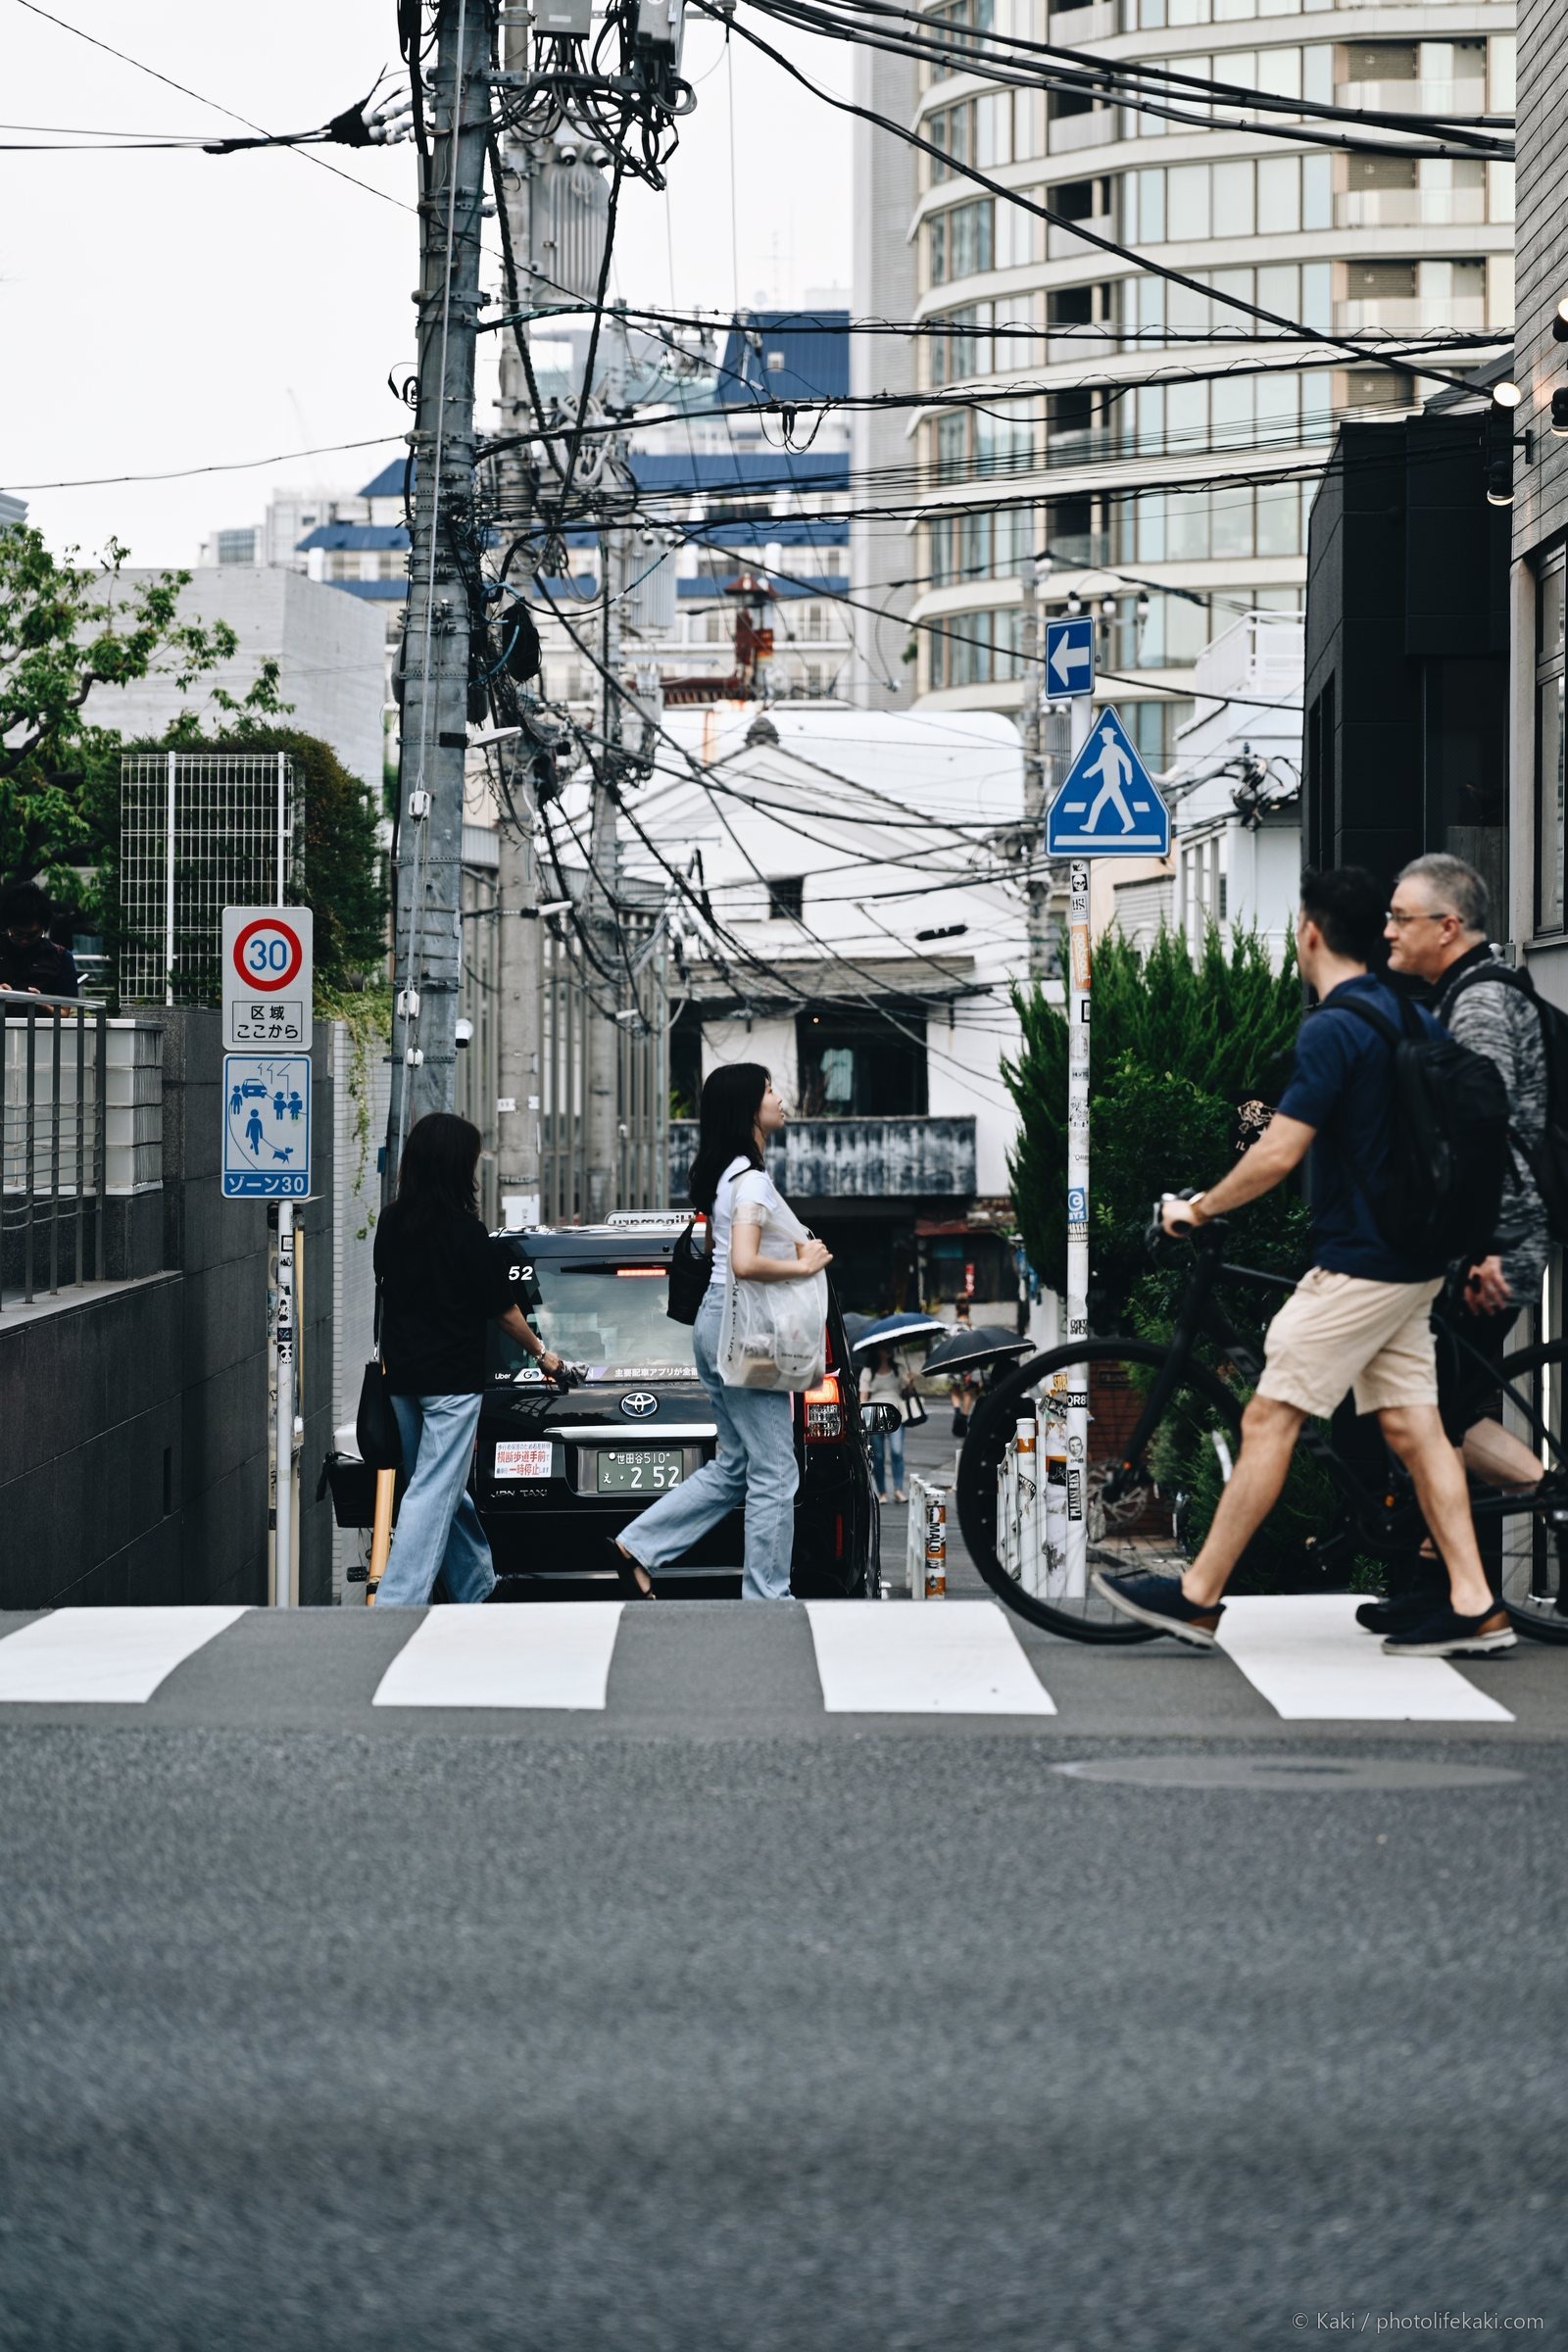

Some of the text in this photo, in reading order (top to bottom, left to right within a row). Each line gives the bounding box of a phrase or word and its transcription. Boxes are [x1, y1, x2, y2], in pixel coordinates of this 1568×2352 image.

[249, 939, 287, 971] 30
[251, 1005, 285, 1020] 区域
[237, 1024, 298, 1039] ここから
[228, 1176, 305, 1194] ゾーン30
[508, 1265, 533, 1281] 52
[494, 1372, 512, 1381] Uber
[617, 1452, 665, 1464] 世田谷510
[604, 1473, 612, 1484] え
